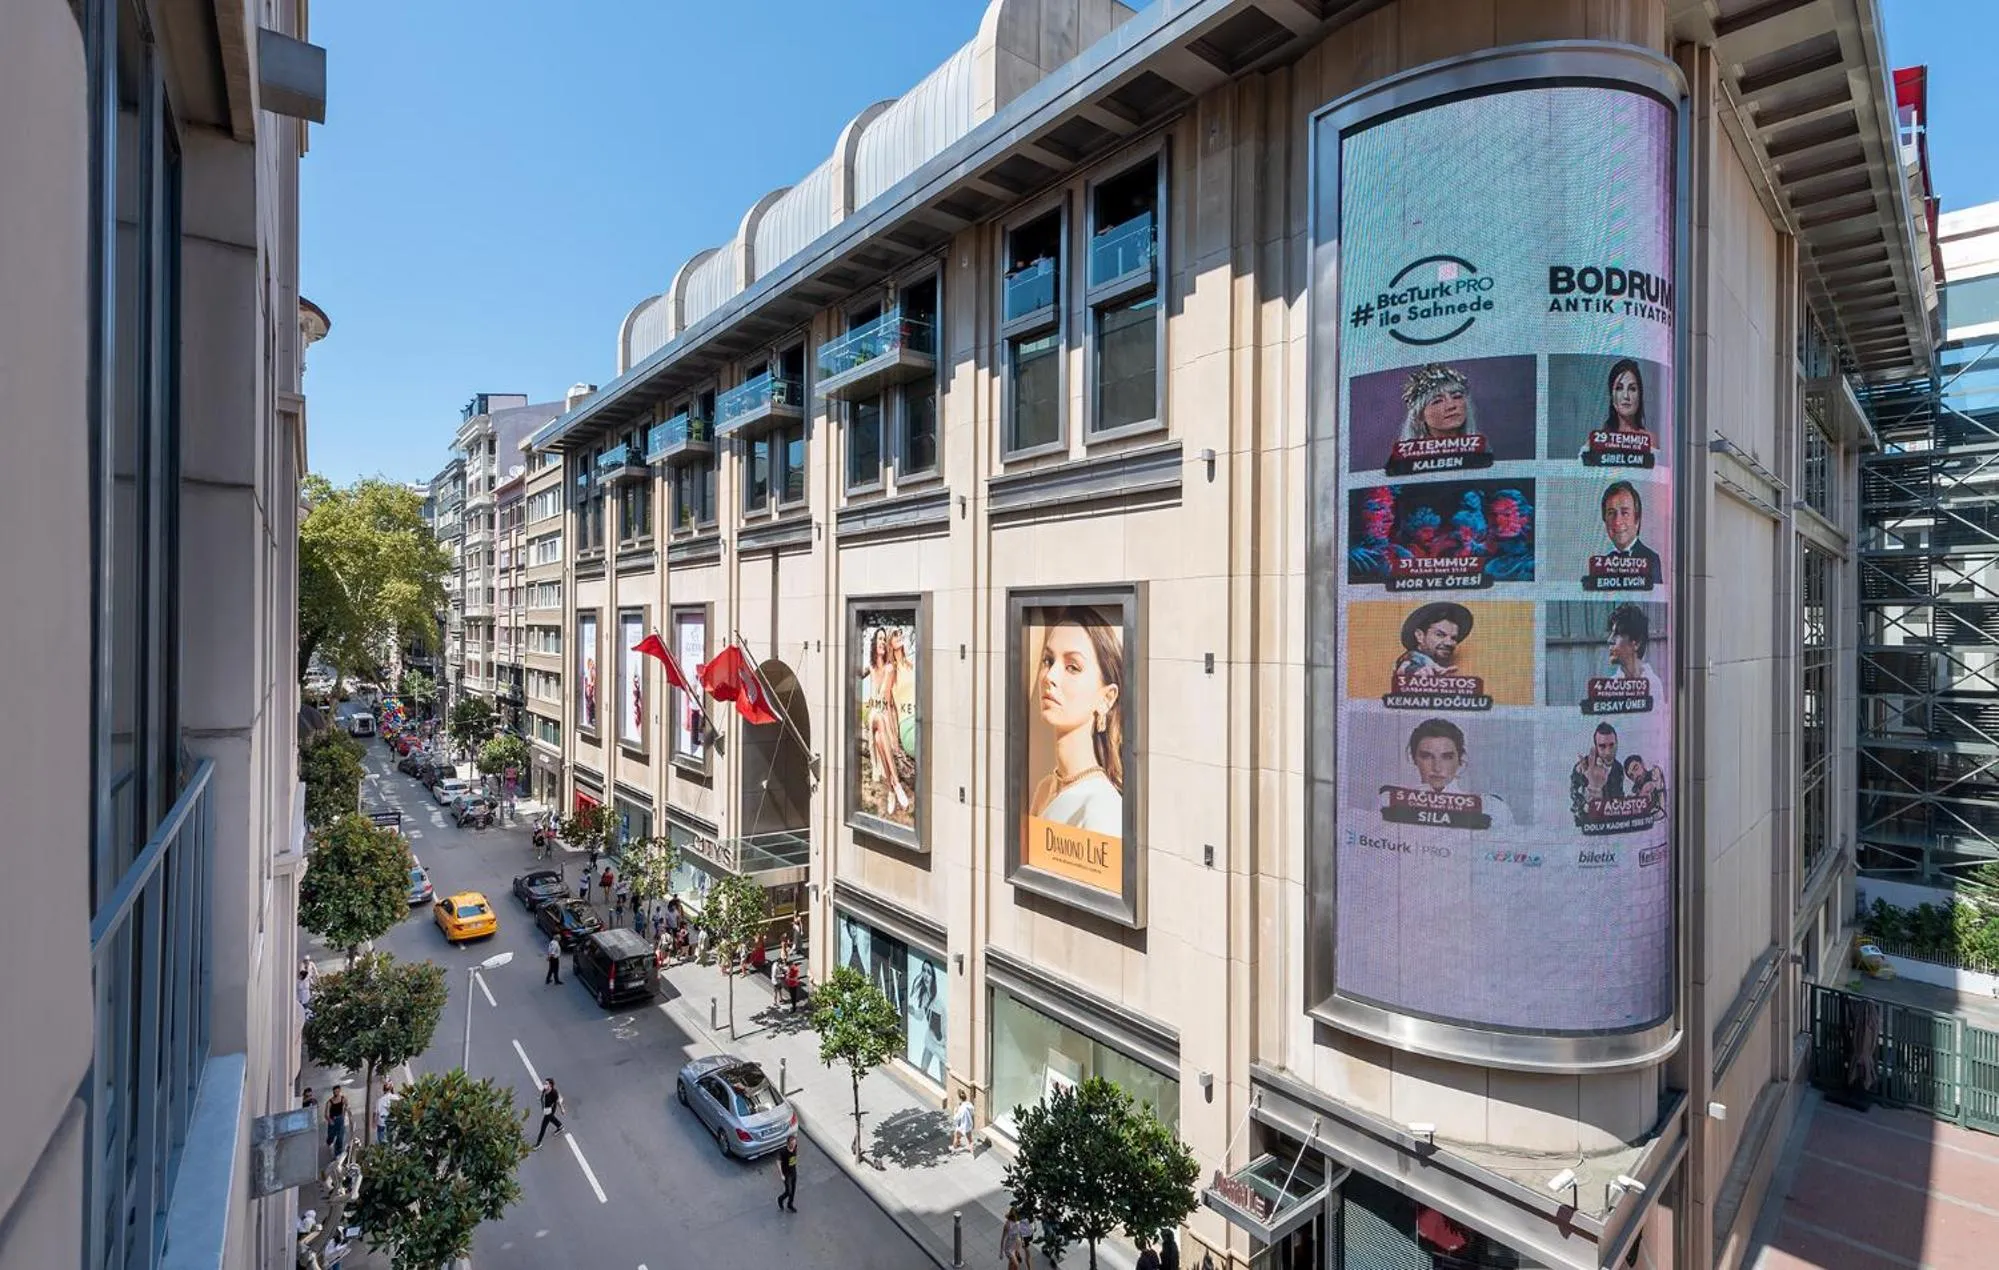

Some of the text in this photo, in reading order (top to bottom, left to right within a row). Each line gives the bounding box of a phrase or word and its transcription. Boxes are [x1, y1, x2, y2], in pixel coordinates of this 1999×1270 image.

[1549, 265, 1672, 312] BODRUM
[1379, 295, 1495, 328] ile Sahnede
[1398, 442, 1415, 454] 27
[1418, 436, 1481, 451] TEMMUZ
[1594, 431, 1607, 443] 29
[1609, 432, 1649, 447] TEMMUZ
[1412, 456, 1464, 472] KALBEN
[1627, 454, 1644, 465] CAN
[1400, 556, 1479, 569] 31 TEMMUZ
[1395, 578, 1423, 589] MOR
[1426, 577, 1443, 587] VE
[1597, 577, 1621, 588] EROL
[1398, 676, 1406, 686] 3
[1594, 680, 1603, 690] 4
[1386, 694, 1488, 708] KENAN DOĞULU
[1593, 700, 1624, 712] ERSAY
[1594, 801, 1602, 812] 7
[1417, 811, 1451, 824] SILA
[1359, 834, 1451, 859] BtcTurk PRO
[1579, 850, 1616, 864] biletix
